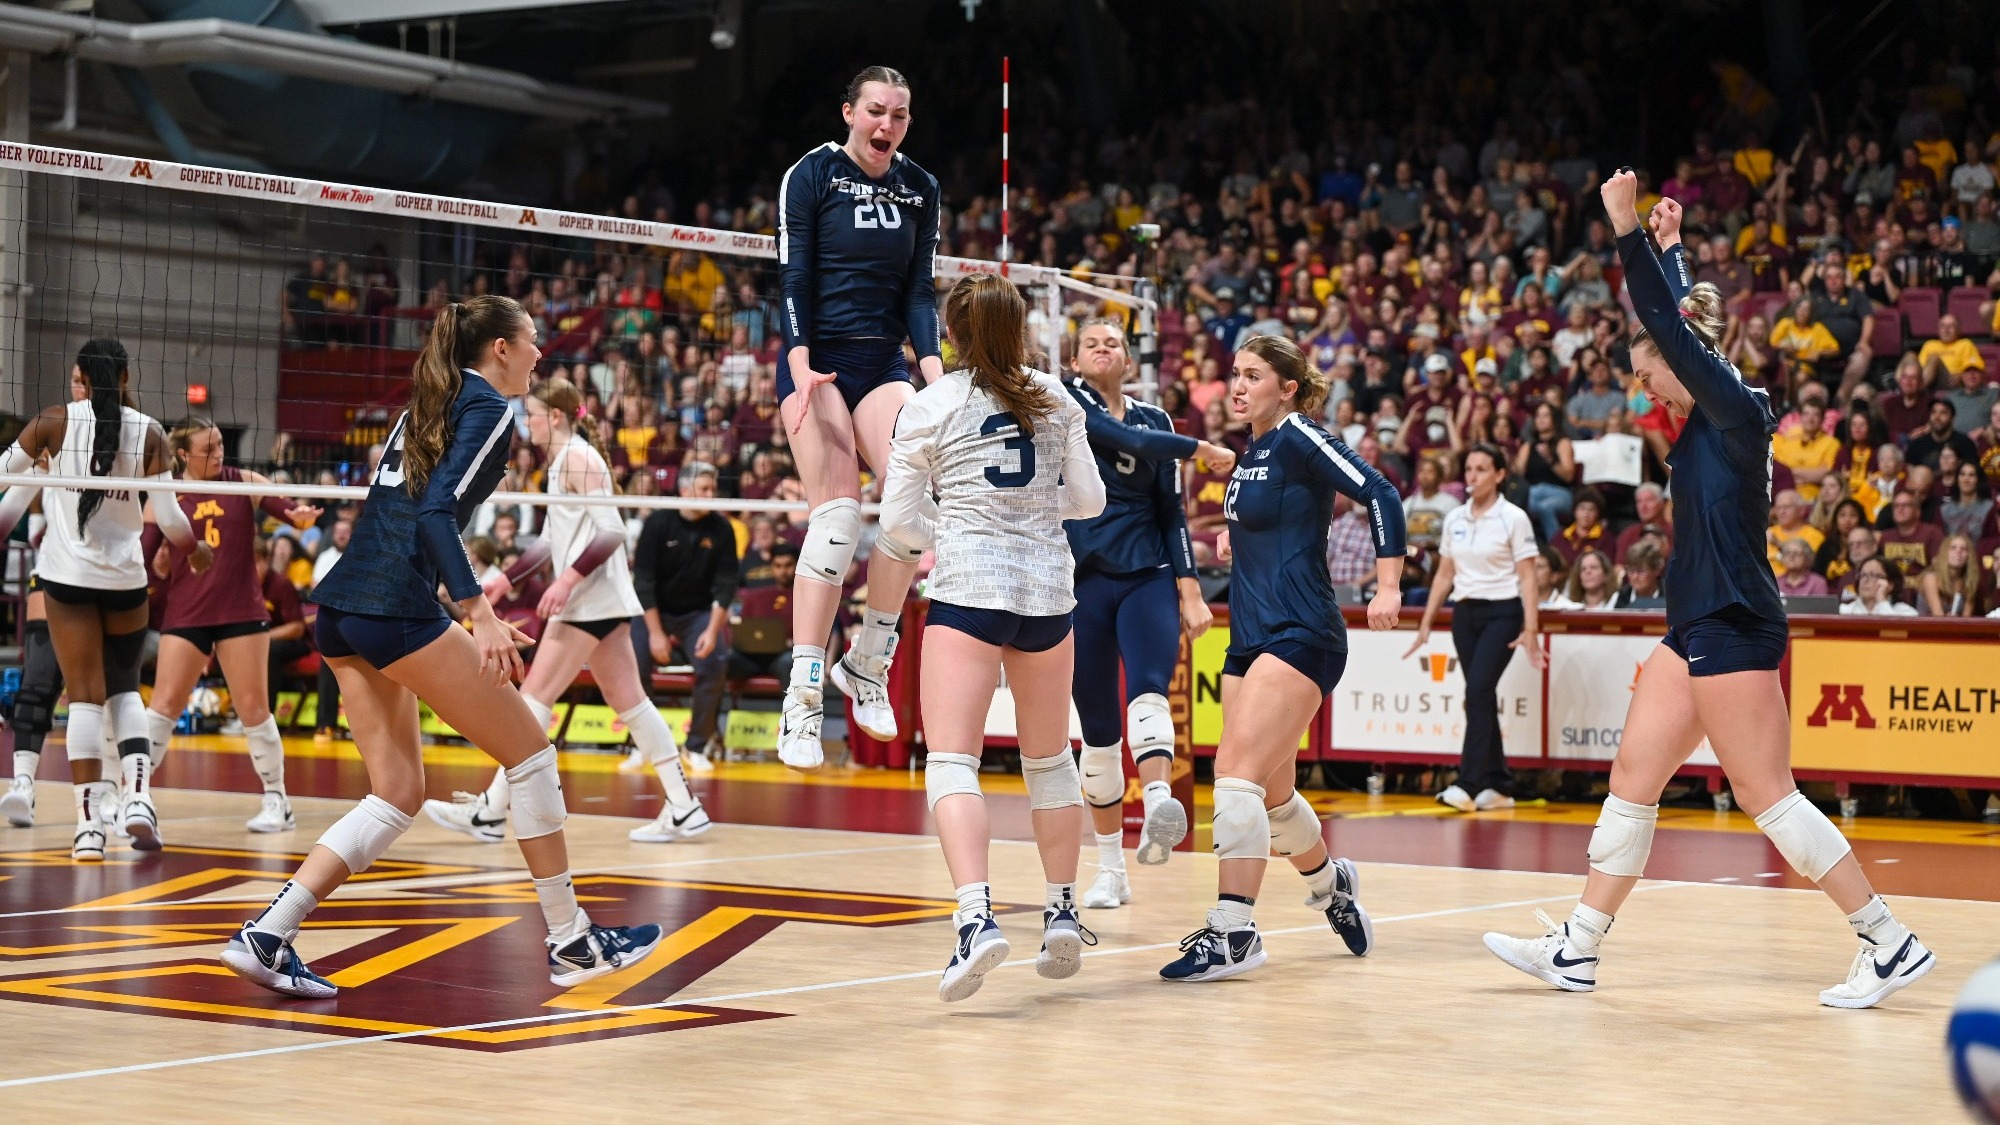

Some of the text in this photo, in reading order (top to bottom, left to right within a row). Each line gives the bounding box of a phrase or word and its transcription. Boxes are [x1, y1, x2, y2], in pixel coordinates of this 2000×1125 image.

[28, 147, 104, 171] VOLLEYBALL
[180, 167, 296, 195] GOPHER VOLLEYBALL
[830, 180, 873, 195] PENN
[395, 195, 498, 219] GOPHER VOLLEYBALL
[854, 194, 902, 229] 20
[559, 214, 654, 237] GOPHER VOLLEYBALL
[982, 410, 1036, 488] 3
[1223, 479, 1240, 522] 12
[204, 518, 221, 549] 6
[1350, 690, 1527, 717] TRUSTNE
[1807, 683, 1877, 729] M
[1888, 716, 1973, 733] FAIRVIEW
